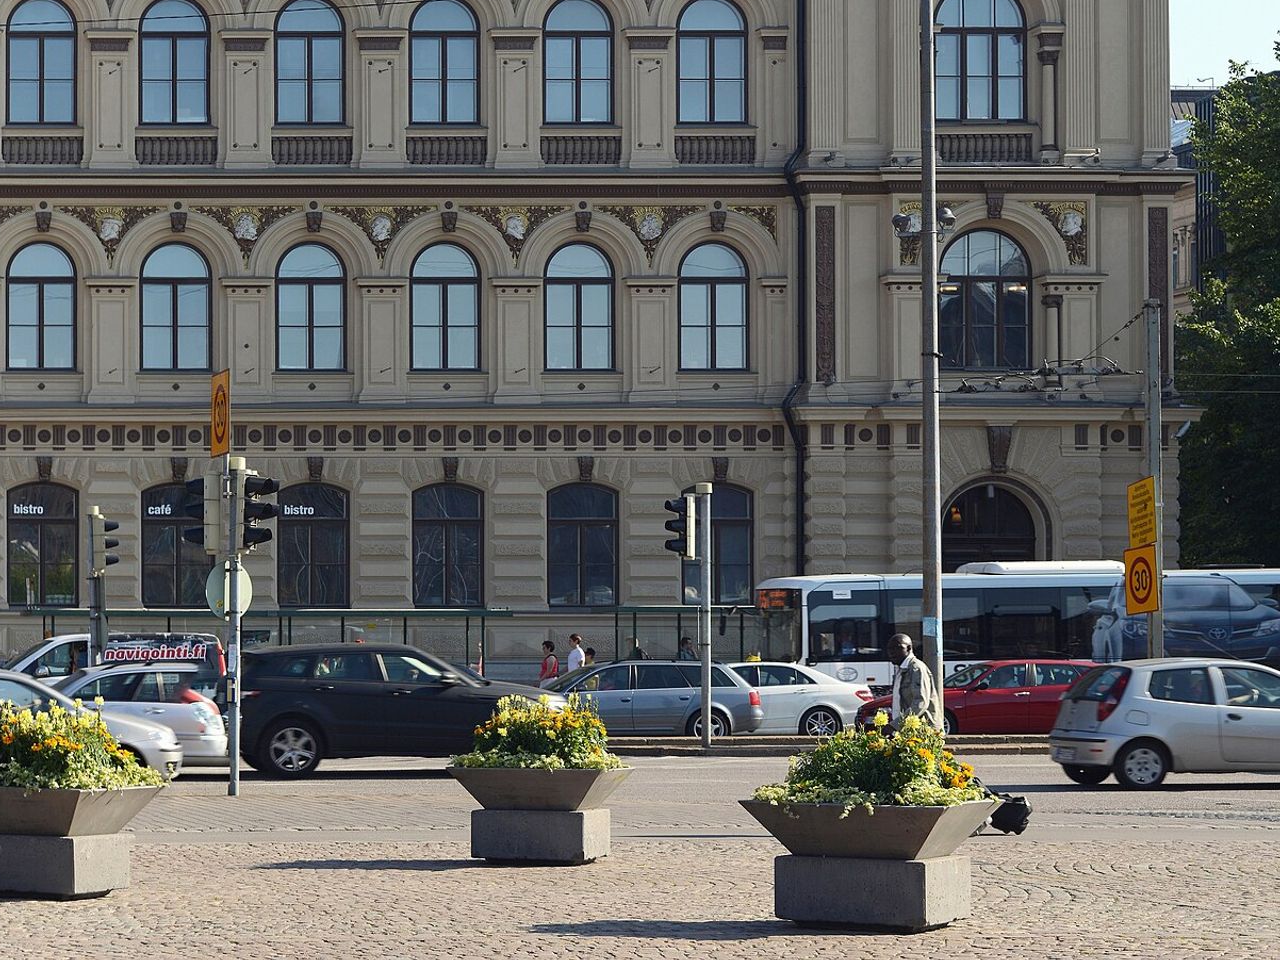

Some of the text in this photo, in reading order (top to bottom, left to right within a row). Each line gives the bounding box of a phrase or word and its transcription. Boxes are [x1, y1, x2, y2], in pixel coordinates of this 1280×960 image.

[13, 503, 44, 515] bistro
[147, 504, 172, 515] café
[284, 504, 315, 515] bistro
[1134, 569, 1149, 592] 30
[104, 643, 207, 662] navigointi.fi
